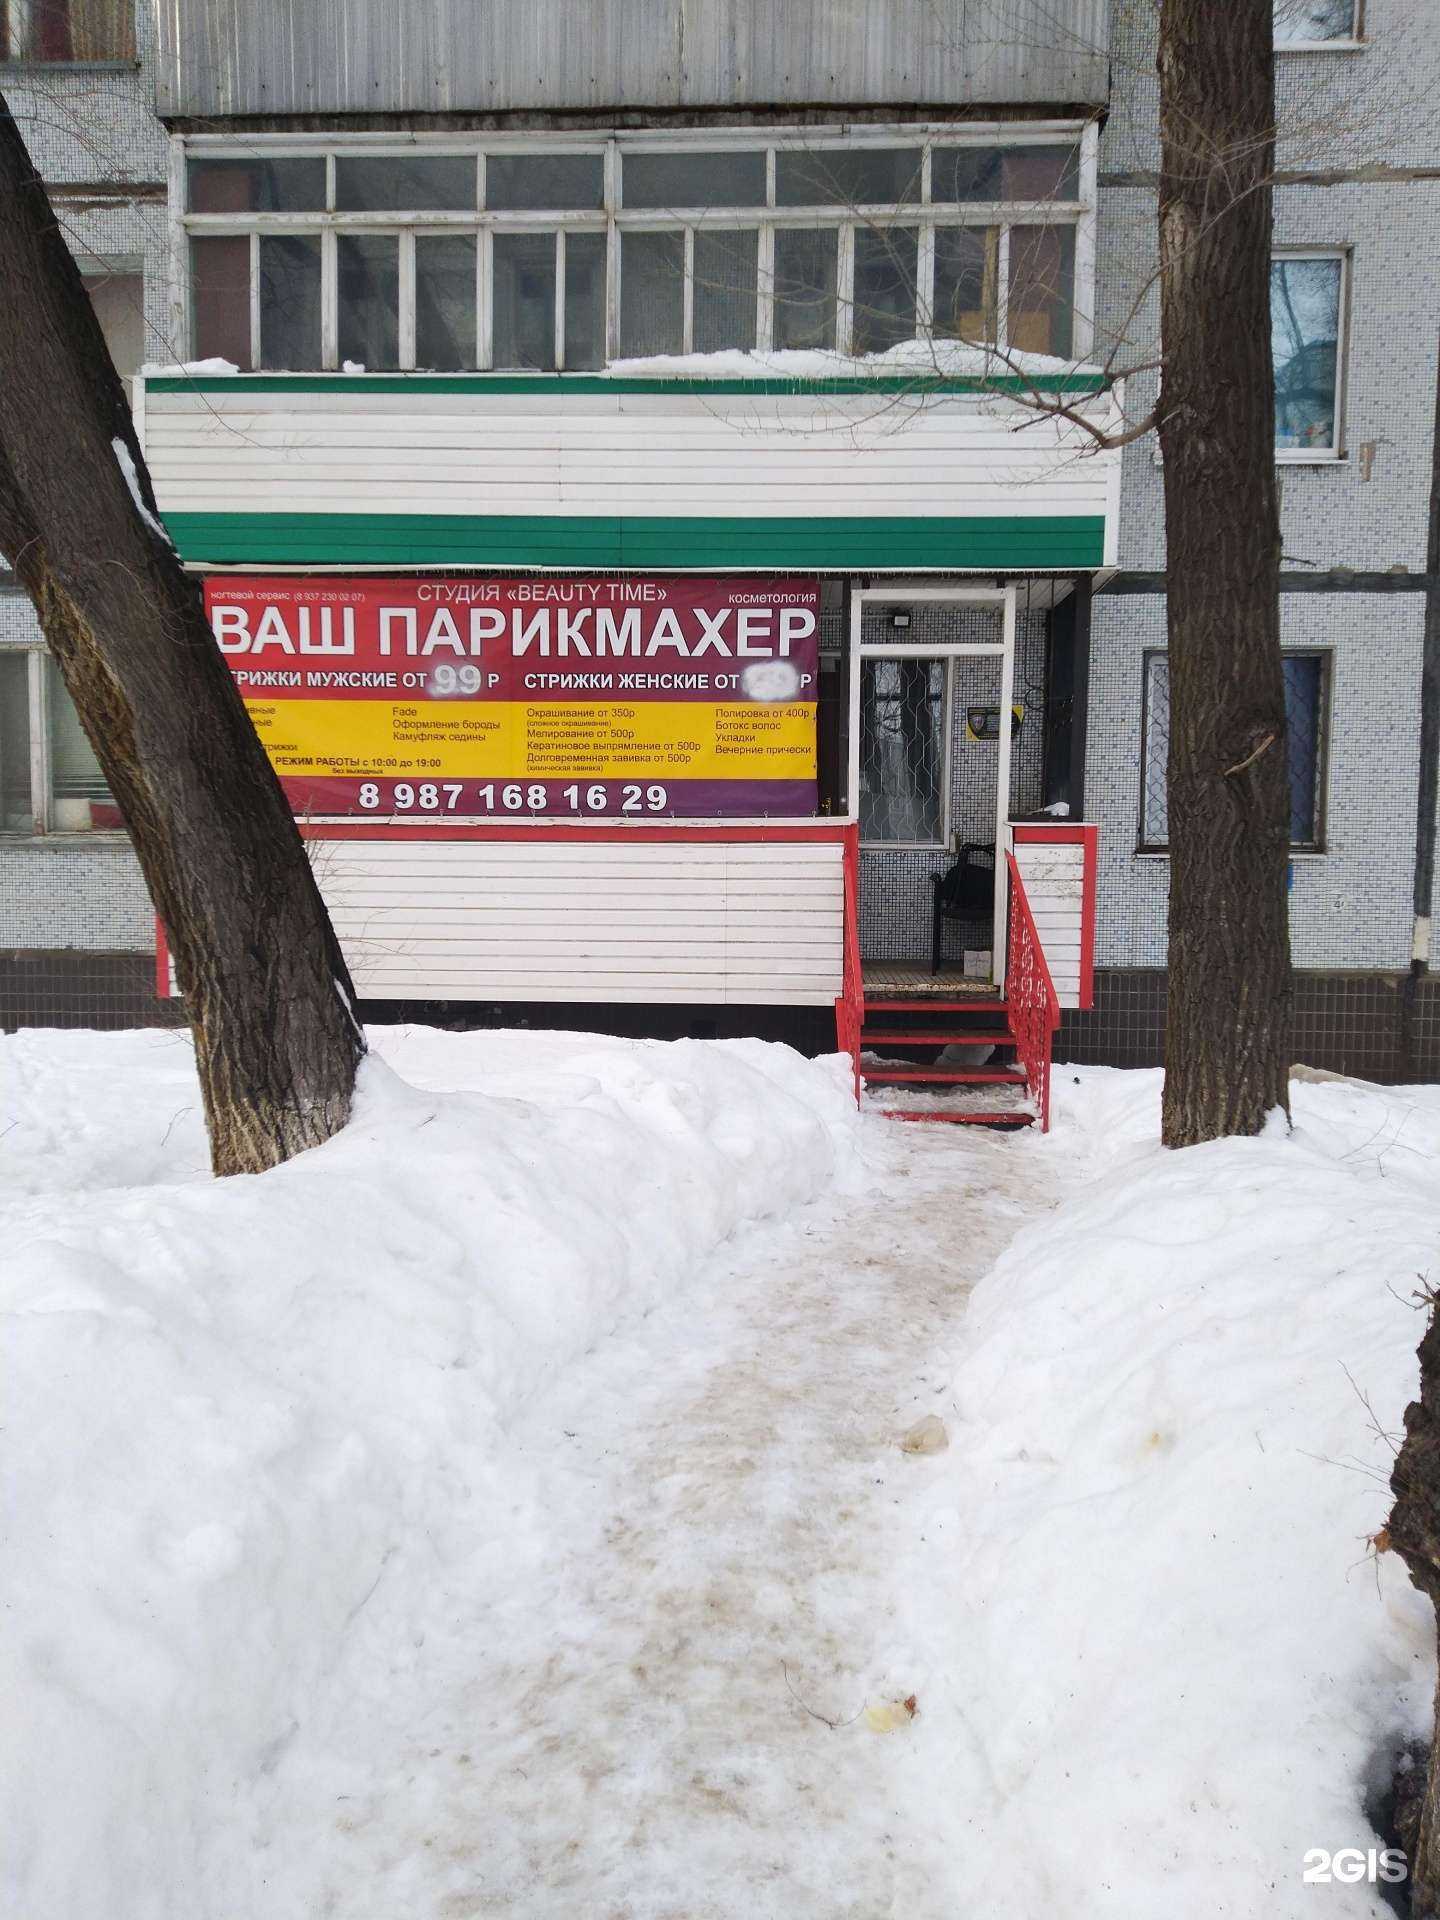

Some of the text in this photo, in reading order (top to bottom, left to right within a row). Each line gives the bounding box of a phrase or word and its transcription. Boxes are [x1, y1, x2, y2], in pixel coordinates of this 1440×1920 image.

[256, 592, 290, 602] сервис
[416, 584, 667, 604] СТУДИЯ «BEAUTY TIME»
[728, 593, 817, 605] косметология
[211, 606, 816, 657] ВАШ ПАРИКМАХЕР
[230, 670, 302, 687] РИЖКИ
[307, 671, 397, 688] МУЖСКИЕ
[402, 672, 428, 688] ОТ
[434, 664, 482, 694] 99
[524, 673, 613, 689] СТРИЖКИ
[618, 673, 709, 689] ЖЕНСКИЕ
[714, 674, 740, 689] ОТ
[392, 707, 417, 717] Fade
[526, 707, 635, 719] Окрашивание от 350р
[715, 708, 810, 720] Полировка от 400р
[392, 719, 500, 730] Оформление бороды
[715, 720, 782, 730] Ботокс волос
[393, 732, 486, 743] Камуфляж седины
[527, 729, 595, 740] Мелирование
[715, 733, 756, 743] Укладки
[527, 741, 590, 752] Кератиновое
[593, 742, 661, 752] выпрямление
[663, 743, 674, 751] от
[715, 745, 812, 755] Вечерние прически
[275, 757, 313, 767] РЕЖИМ
[316, 757, 360, 767] РАБОТЫ
[372, 758, 397, 767] 10:00
[399, 760, 413, 769] до
[416, 758, 441, 768] 19:00
[526, 753, 610, 764] Долговременная
[667, 753, 692, 764] 500р
[359, 783, 667, 811] 8 987 168 16 29
